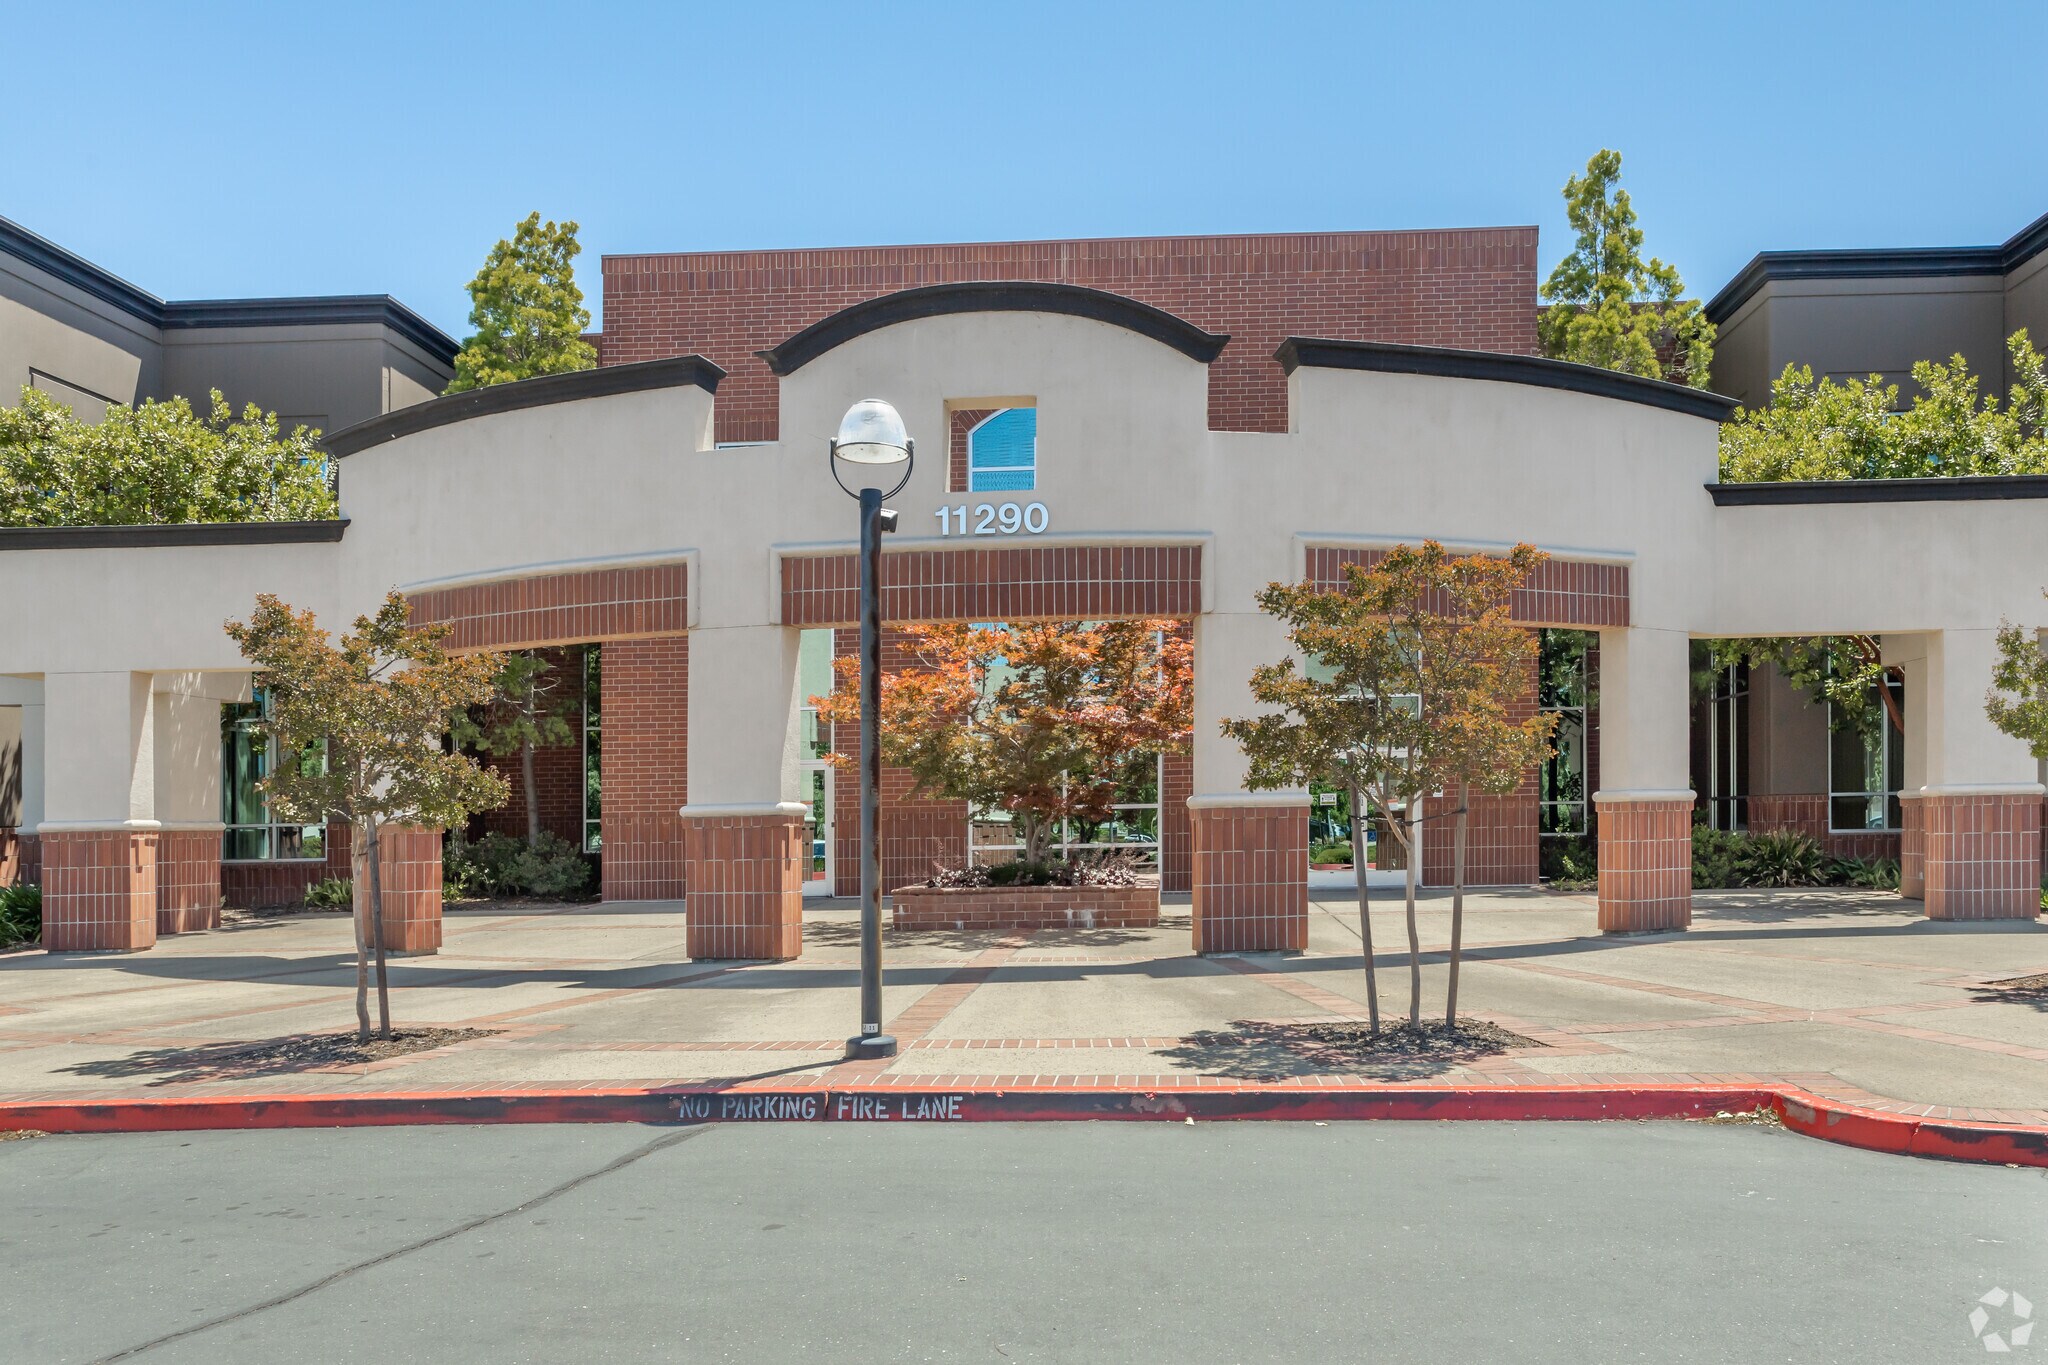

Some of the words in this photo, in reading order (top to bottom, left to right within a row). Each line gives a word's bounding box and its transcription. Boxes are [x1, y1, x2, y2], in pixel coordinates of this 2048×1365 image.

[935, 502, 1049, 536] 11290
[679, 1097, 710, 1119] NO
[721, 1096, 816, 1119] PARKING
[837, 1096, 890, 1119] FIRE
[901, 1096, 964, 1119] LANE
